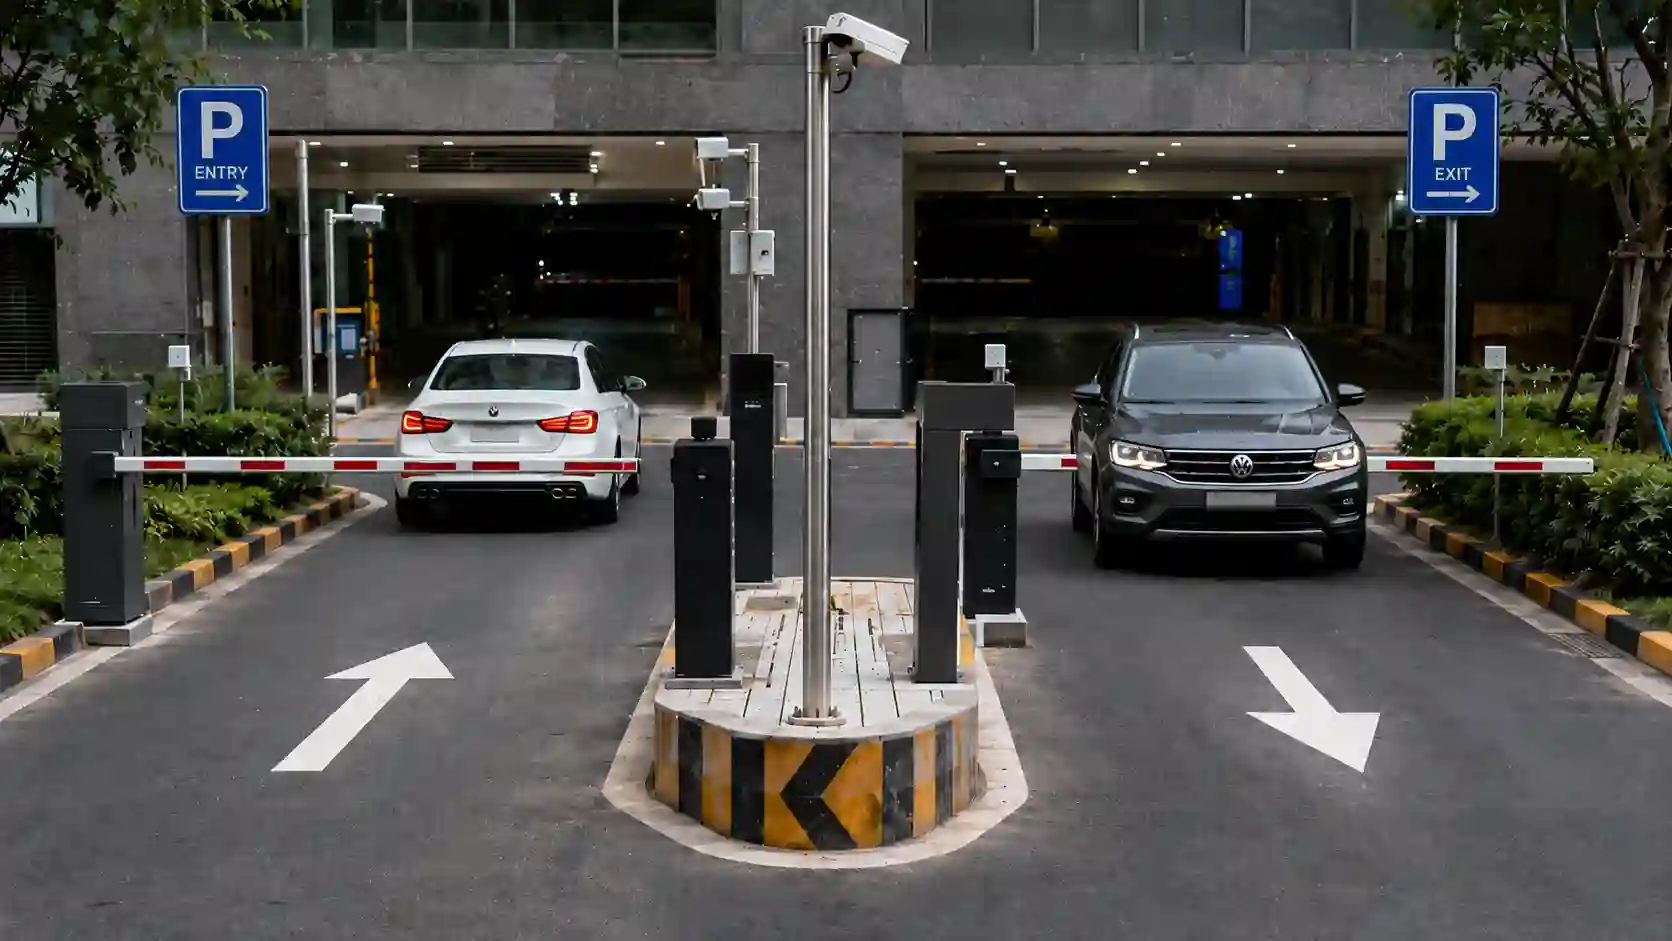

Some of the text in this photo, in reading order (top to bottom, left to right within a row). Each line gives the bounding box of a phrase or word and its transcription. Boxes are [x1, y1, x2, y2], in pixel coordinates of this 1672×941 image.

[201, 101, 243, 159] P
[1433, 103, 1477, 161] P
[195, 165, 248, 180] ENTRY
[1435, 167, 1472, 181] EXIT
